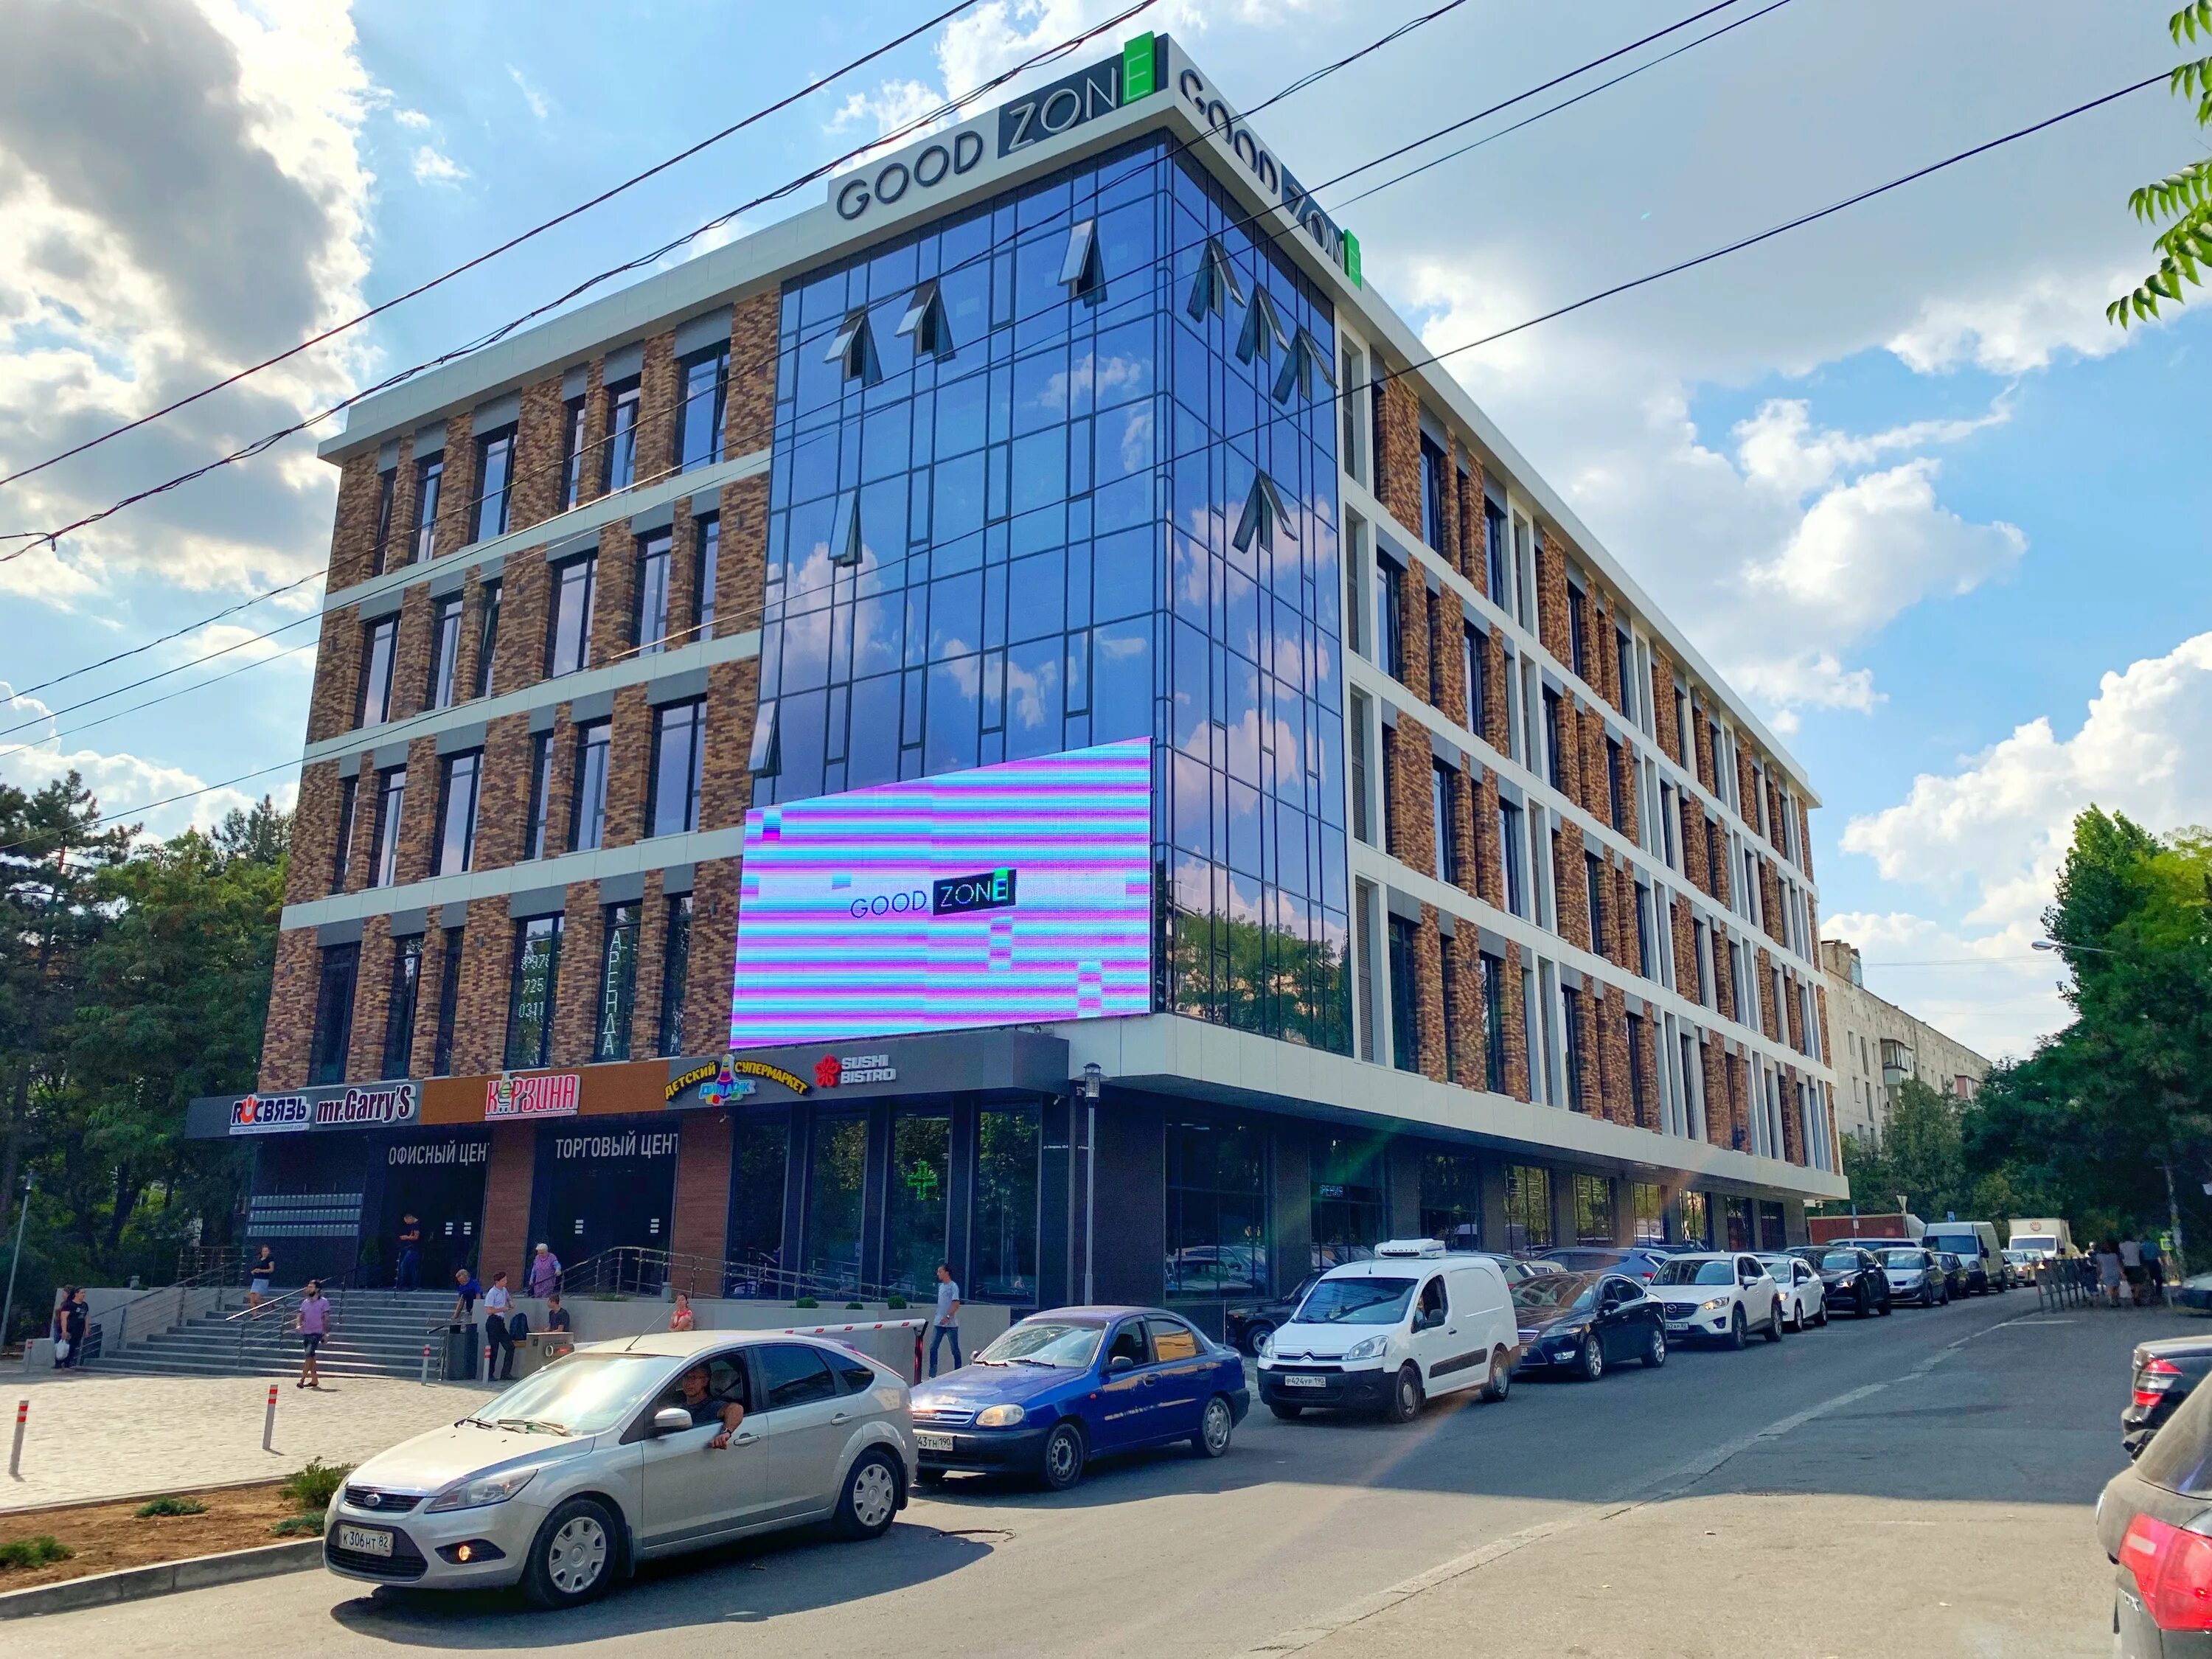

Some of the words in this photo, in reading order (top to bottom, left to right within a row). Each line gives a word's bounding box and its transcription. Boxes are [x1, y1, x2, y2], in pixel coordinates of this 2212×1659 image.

[836, 130, 984, 220] GOOD
[1008, 52, 1151, 151] ZONE
[1180, 69, 1279, 195] GOOD
[1286, 184, 1362, 287] ZONE
[850, 890, 927, 919] GOOD
[940, 877, 1009, 908] ZONE
[523, 978, 544, 994] 725
[602, 930, 622, 1055] АРЕНДА
[841, 1054, 889, 1070] SUSHI
[664, 1062, 716, 1101] ДЕТСКИЙ
[735, 1062, 808, 1095] СУПЕРМАРКЕТ
[840, 1068, 897, 1084] BISTRO
[389, 1140, 455, 1165] ОФИСНЫЙ
[459, 1142, 490, 1166] ЦЕН
[556, 1130, 636, 1159] ТОРГОВЫЙ
[916, 1436, 937, 1447] 43ТН
[343, 1531, 376, 1548] К306НТ
[378, 1535, 389, 1548] 82
